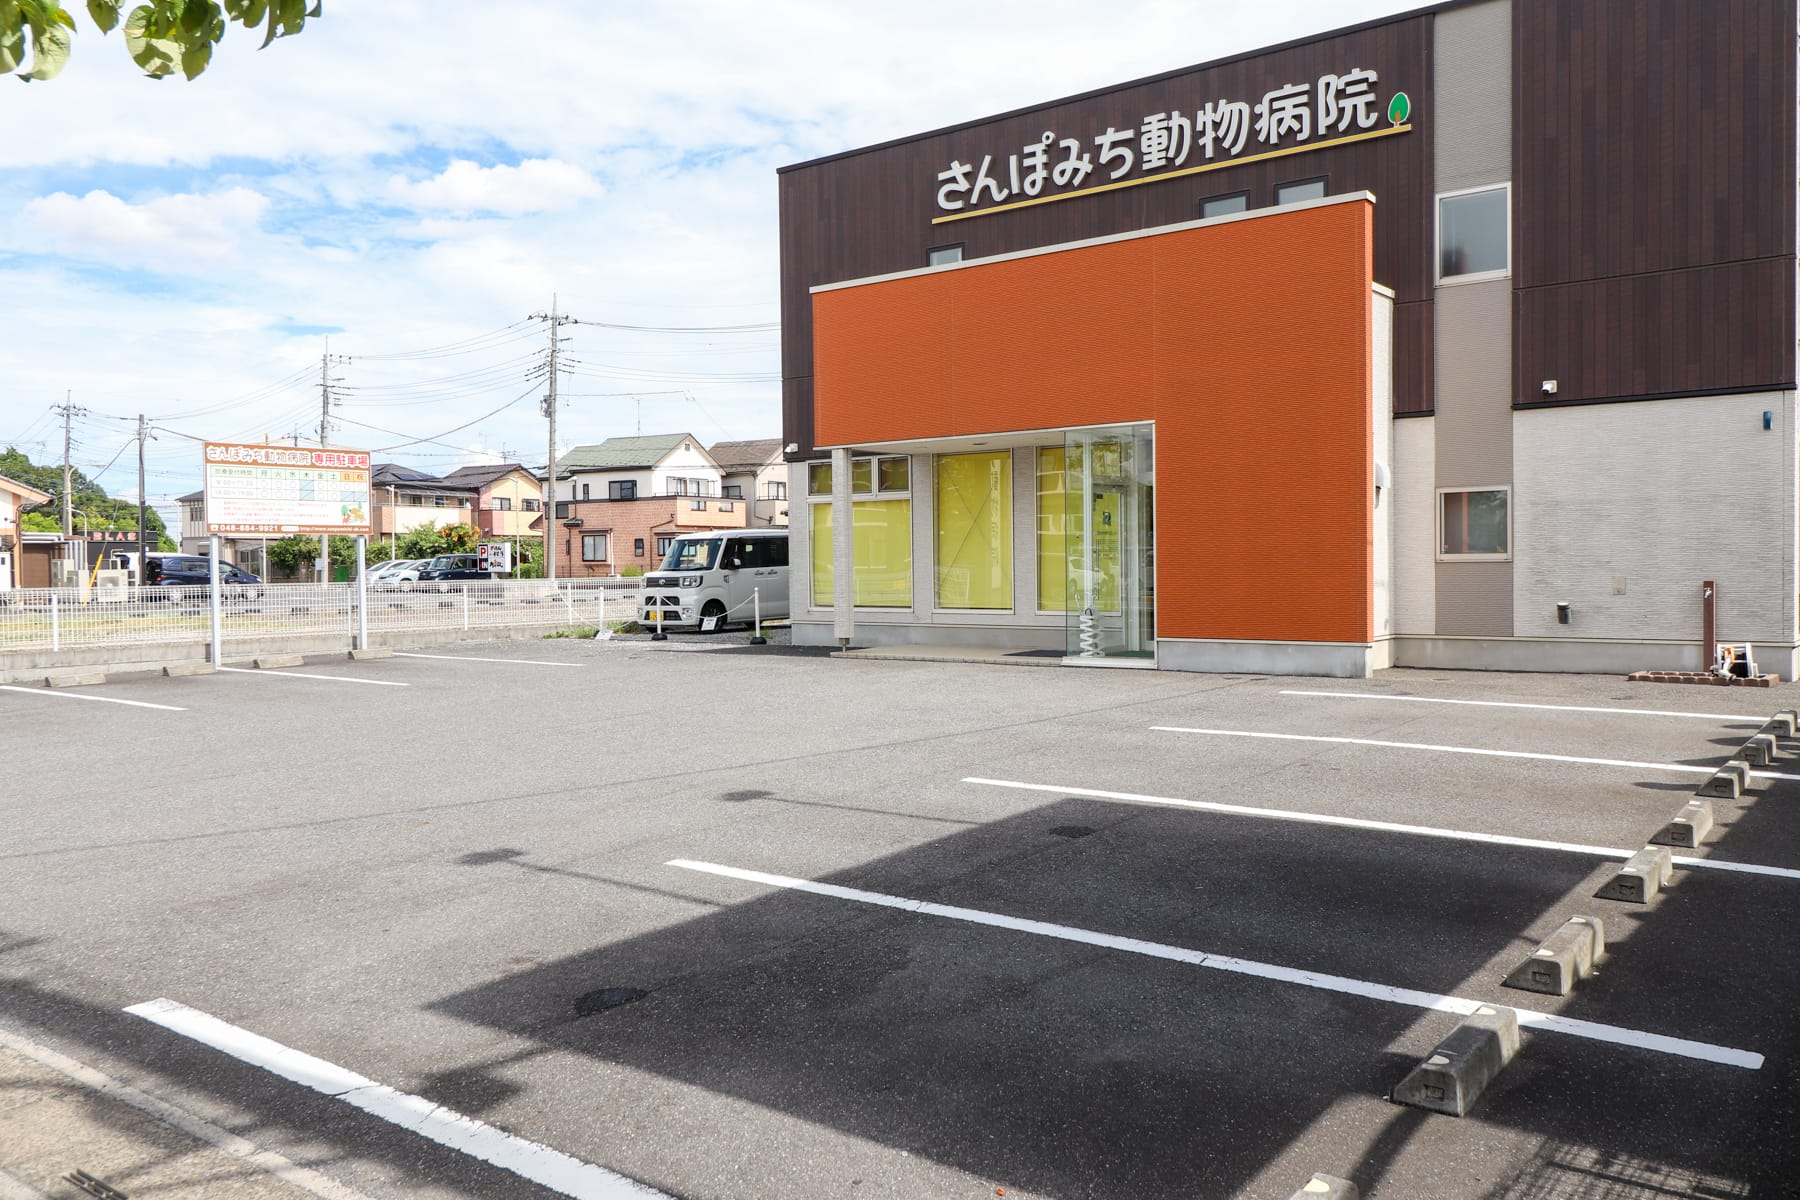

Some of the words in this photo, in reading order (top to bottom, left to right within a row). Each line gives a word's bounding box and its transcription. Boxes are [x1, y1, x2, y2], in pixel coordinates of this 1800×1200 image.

[936, 67, 1380, 212] さんぽみち動物病院
[314, 453, 369, 467] 専用駐車場
[480, 547, 486, 557] P
[480, 561, 488, 569] IN
